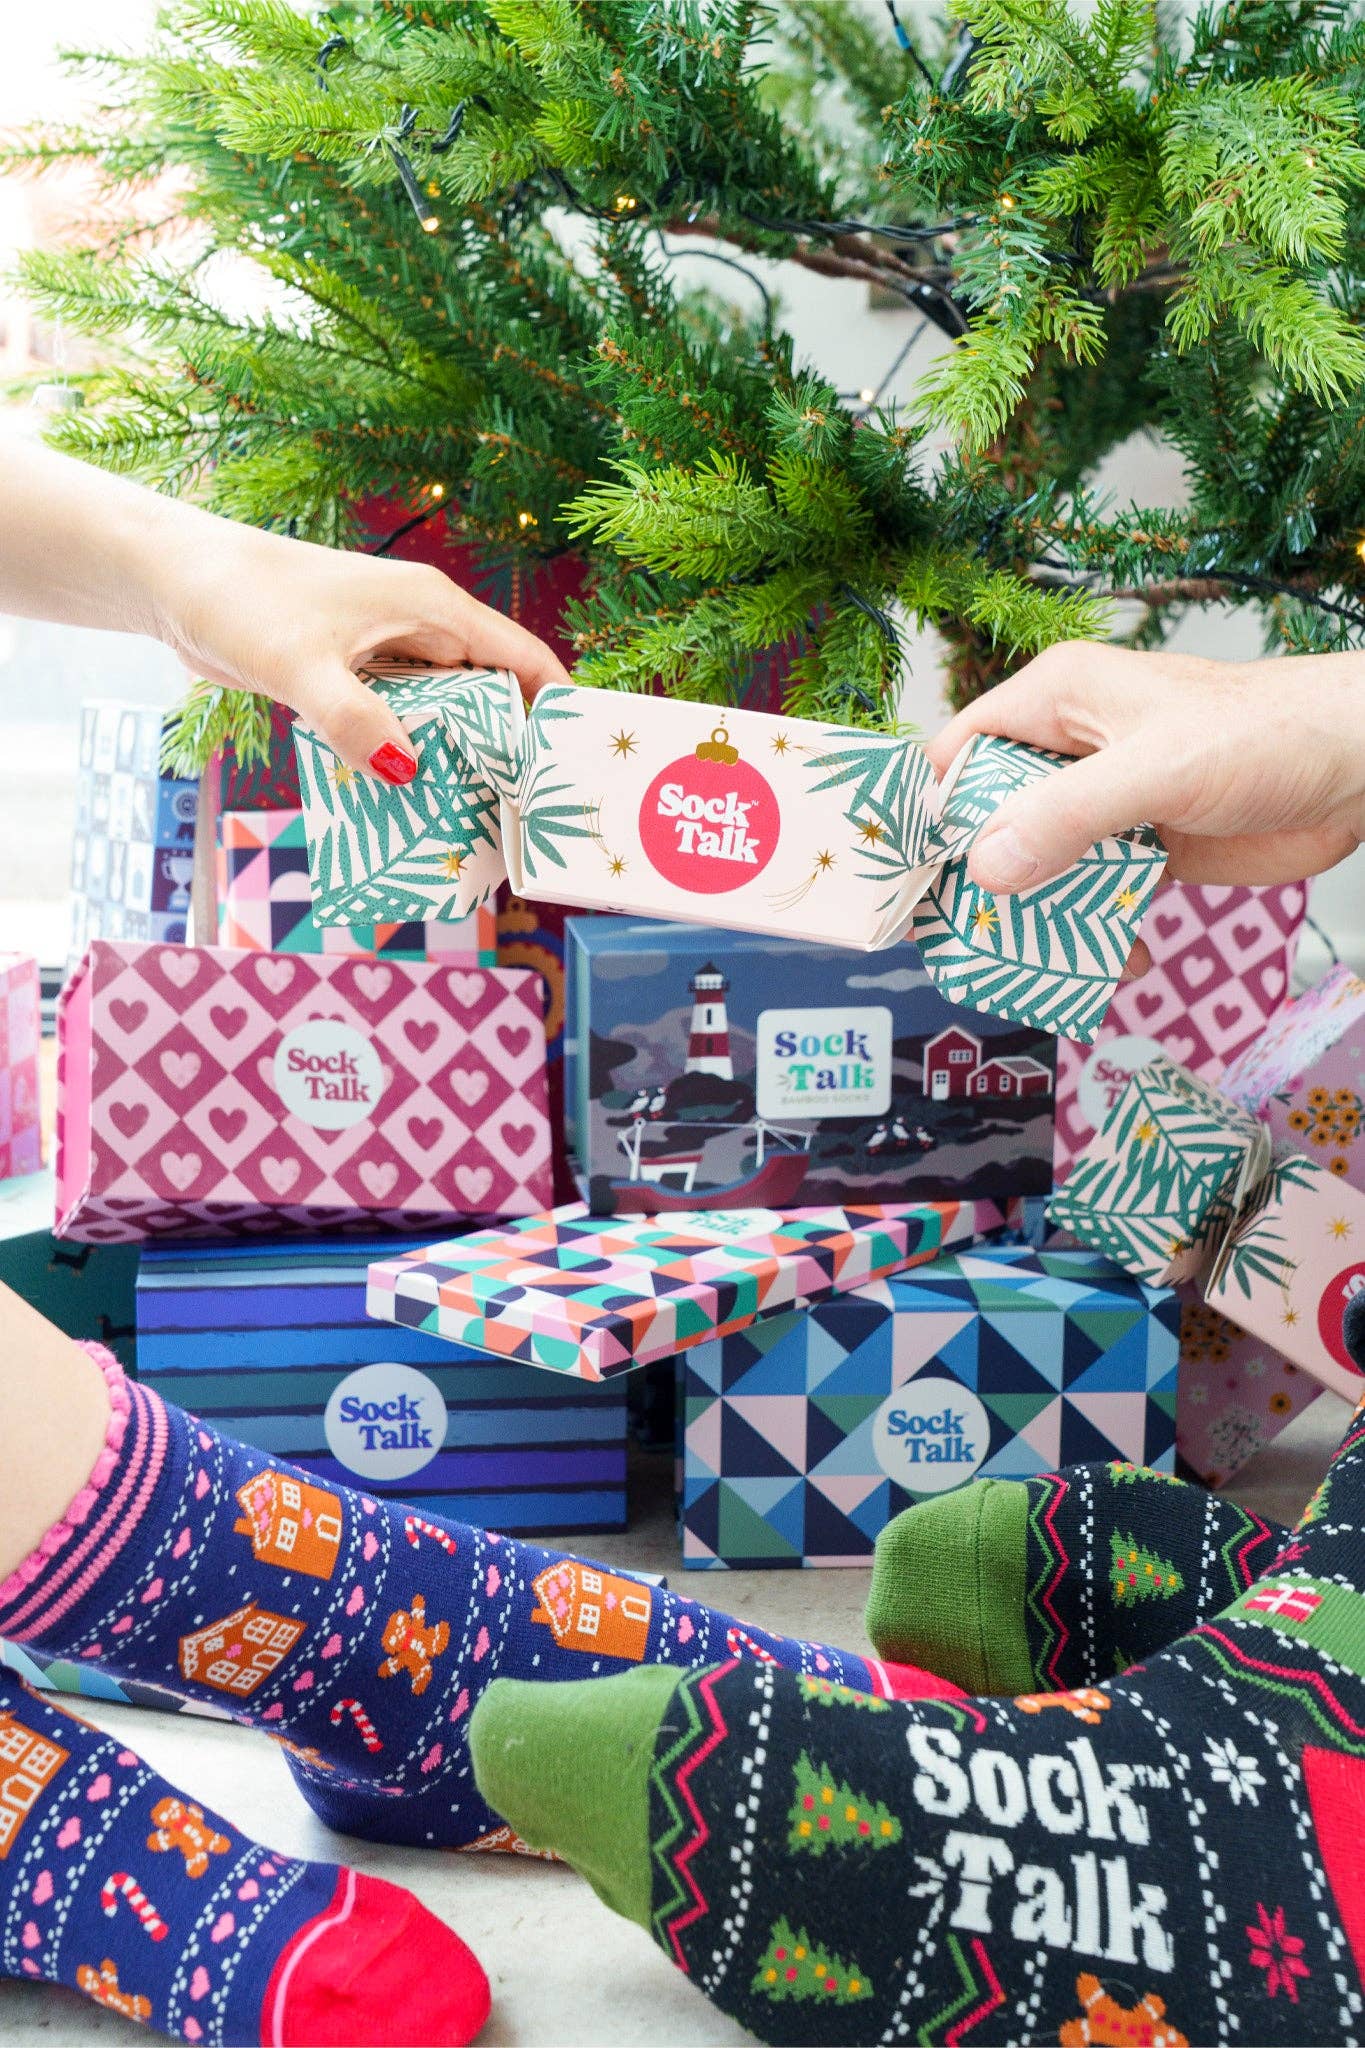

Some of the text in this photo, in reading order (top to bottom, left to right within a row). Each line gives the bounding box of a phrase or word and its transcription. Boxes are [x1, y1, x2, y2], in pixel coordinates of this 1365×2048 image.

[674, 820, 761, 864] Talk
[774, 1029, 872, 1062] Sock
[287, 1048, 359, 1075] Sock
[304, 1076, 371, 1102] Talk
[787, 1063, 875, 1091] Talk
[339, 1394, 422, 1423] Sock
[887, 1408, 964, 1435] Sock
[358, 1422, 433, 1450] Talk
[904, 1436, 975, 1463] Talk
[943, 1829, 1175, 1973] Talk
